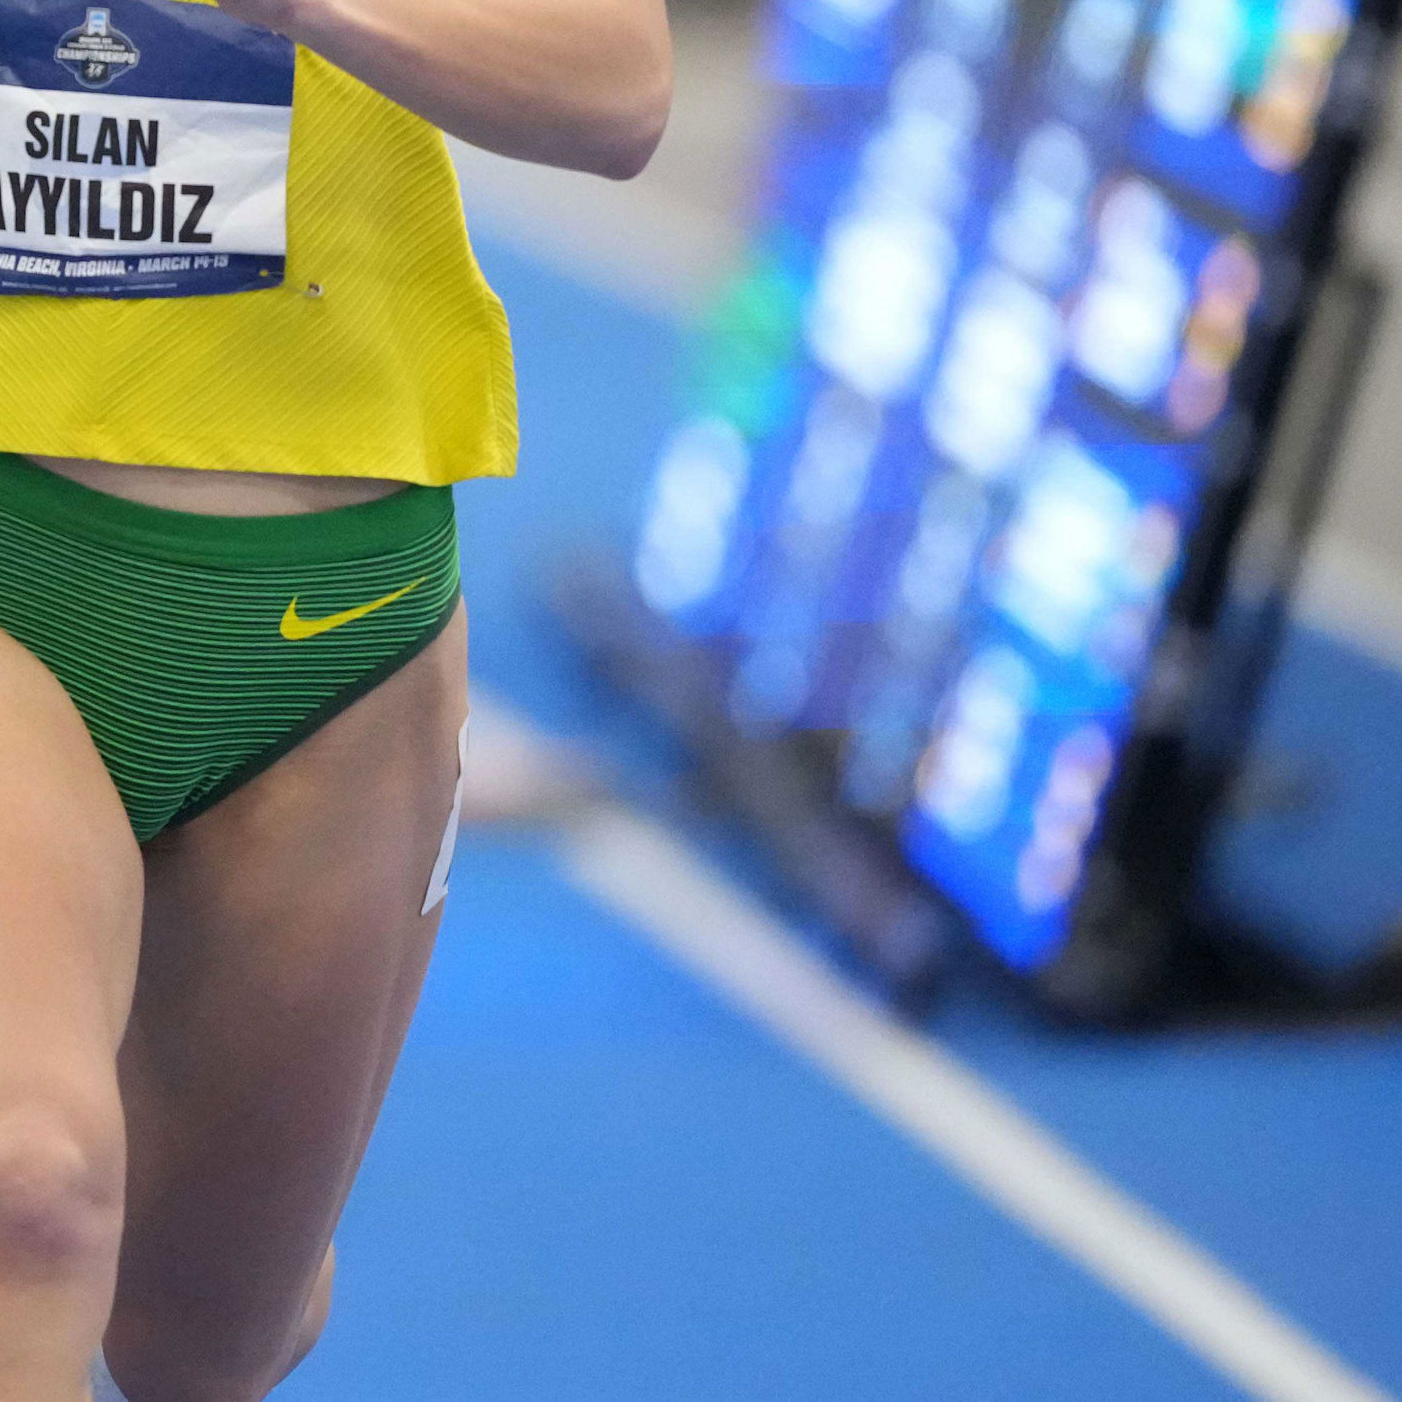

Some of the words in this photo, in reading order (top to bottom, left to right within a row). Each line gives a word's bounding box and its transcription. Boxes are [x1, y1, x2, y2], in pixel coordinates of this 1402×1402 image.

[24, 110, 159, 167] SILAN
[65, 259, 126, 277] VIRGINIA
[137, 257, 191, 273] MARCH
